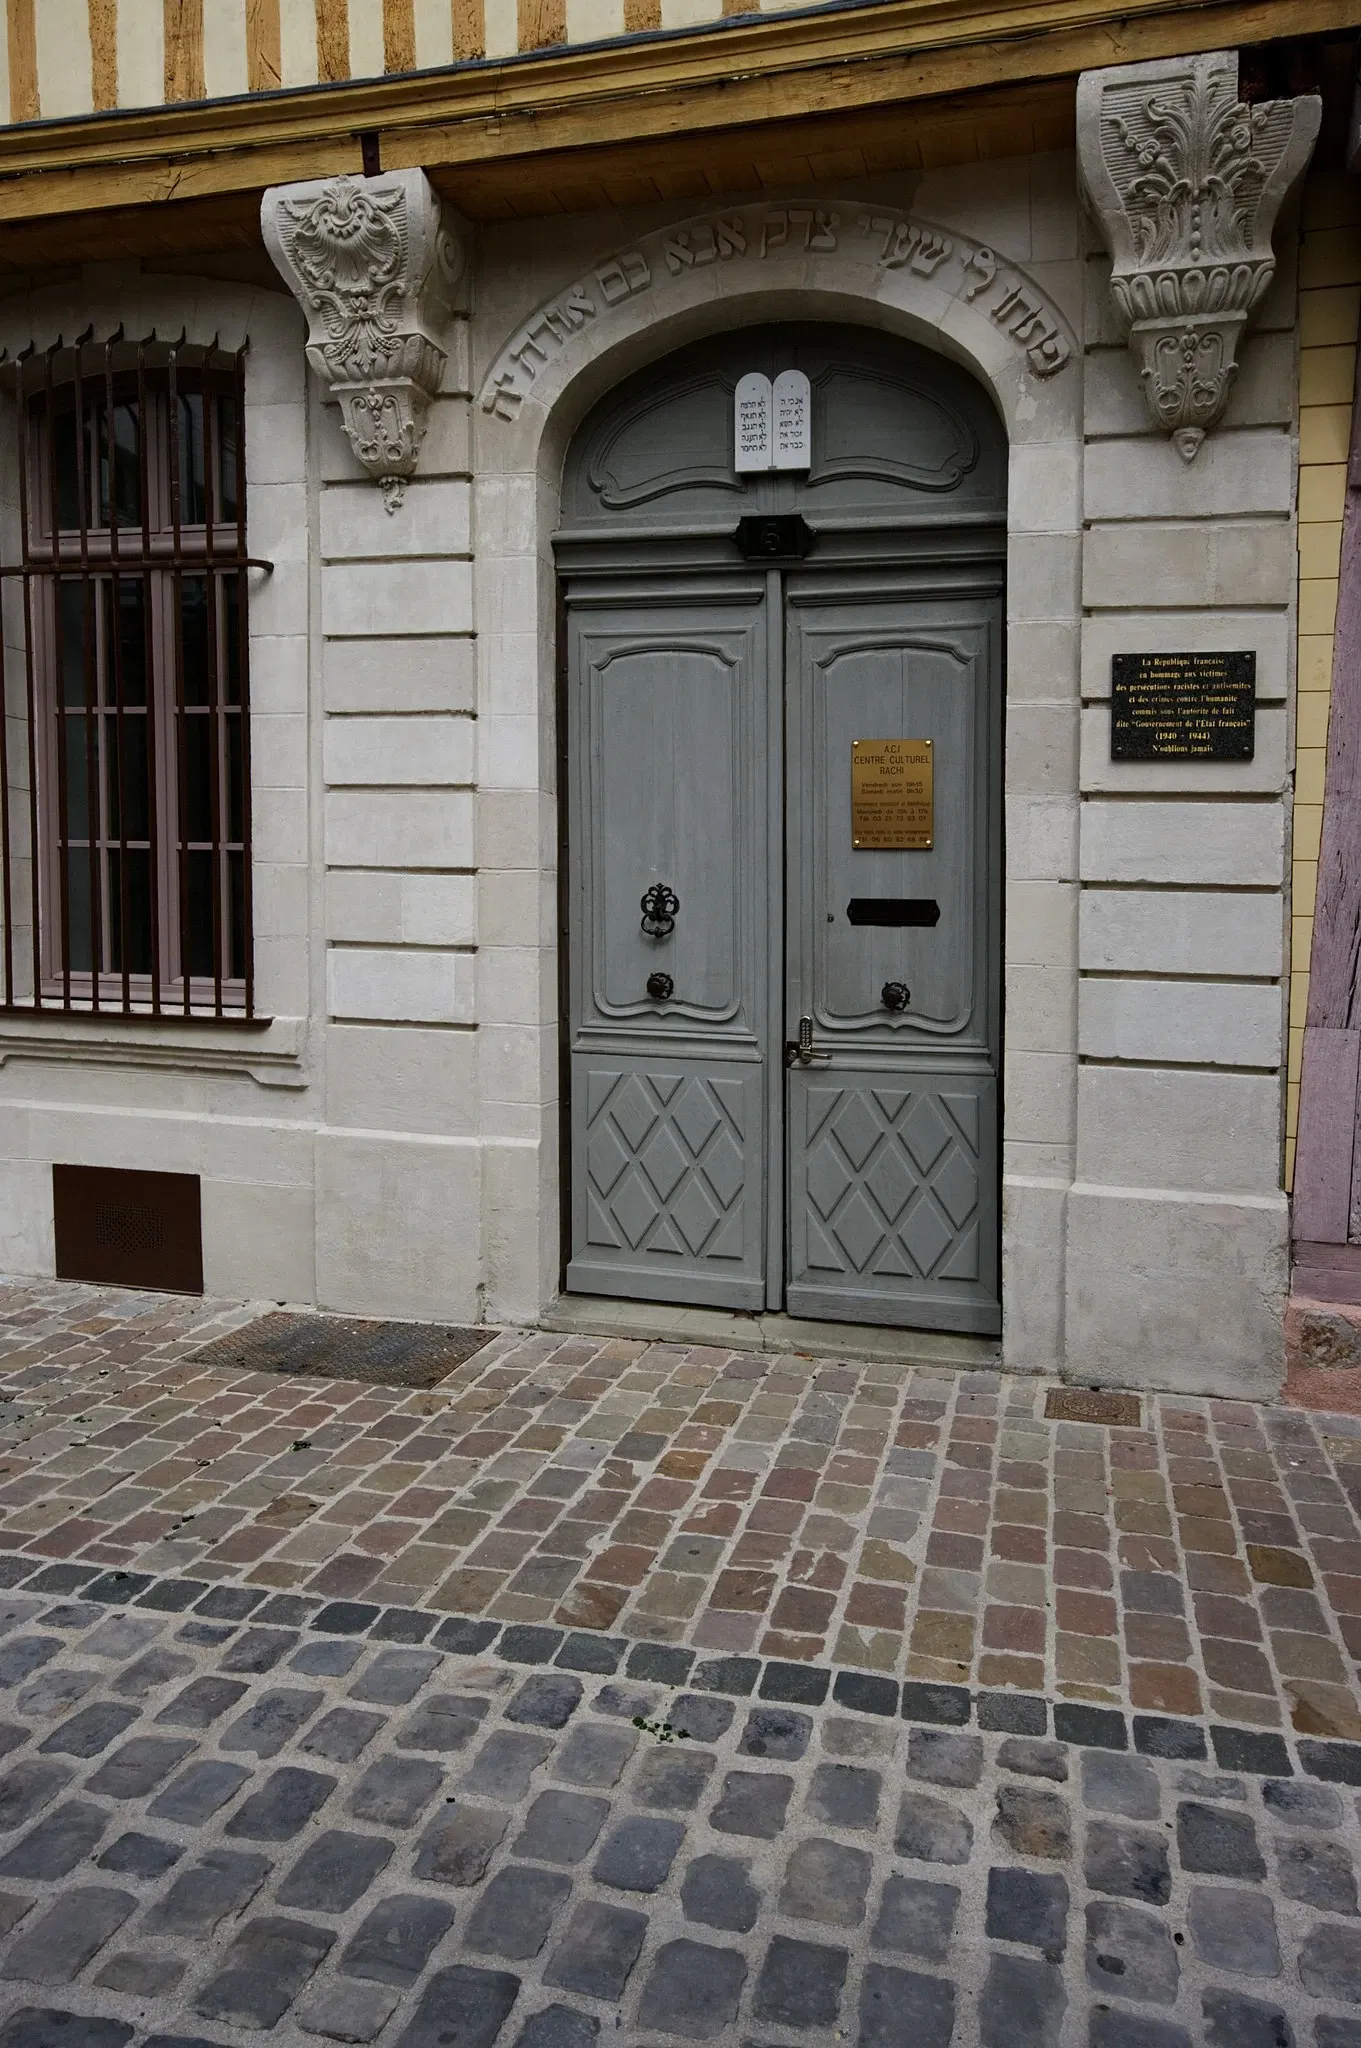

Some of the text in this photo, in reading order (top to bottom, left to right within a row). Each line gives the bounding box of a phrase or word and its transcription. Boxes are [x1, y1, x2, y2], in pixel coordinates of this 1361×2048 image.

[760, 209, 840, 259] צדק
[663, 216, 748, 276] אבא
[858, 214, 952, 276] שערי
[960, 246, 996, 300] לי
[595, 251, 651, 306] בם
[992, 276, 1070, 377] פתחו
[481, 372, 522, 423] יה
[758, 396, 766, 407] לא
[758, 408, 766, 418] לא
[795, 405, 803, 415] לא
[759, 418, 766, 428] לא
[796, 415, 804, 426] לא
[759, 430, 767, 440] לא
[759, 441, 767, 451] לא
[1150, 671, 1181, 679] hommage
[1155, 732, 1177, 740] (1940
[1189, 732, 1210, 740] 1944)
[1191, 745, 1213, 753] jamais
[854, 756, 931, 764] CENTRE CULTUREL
